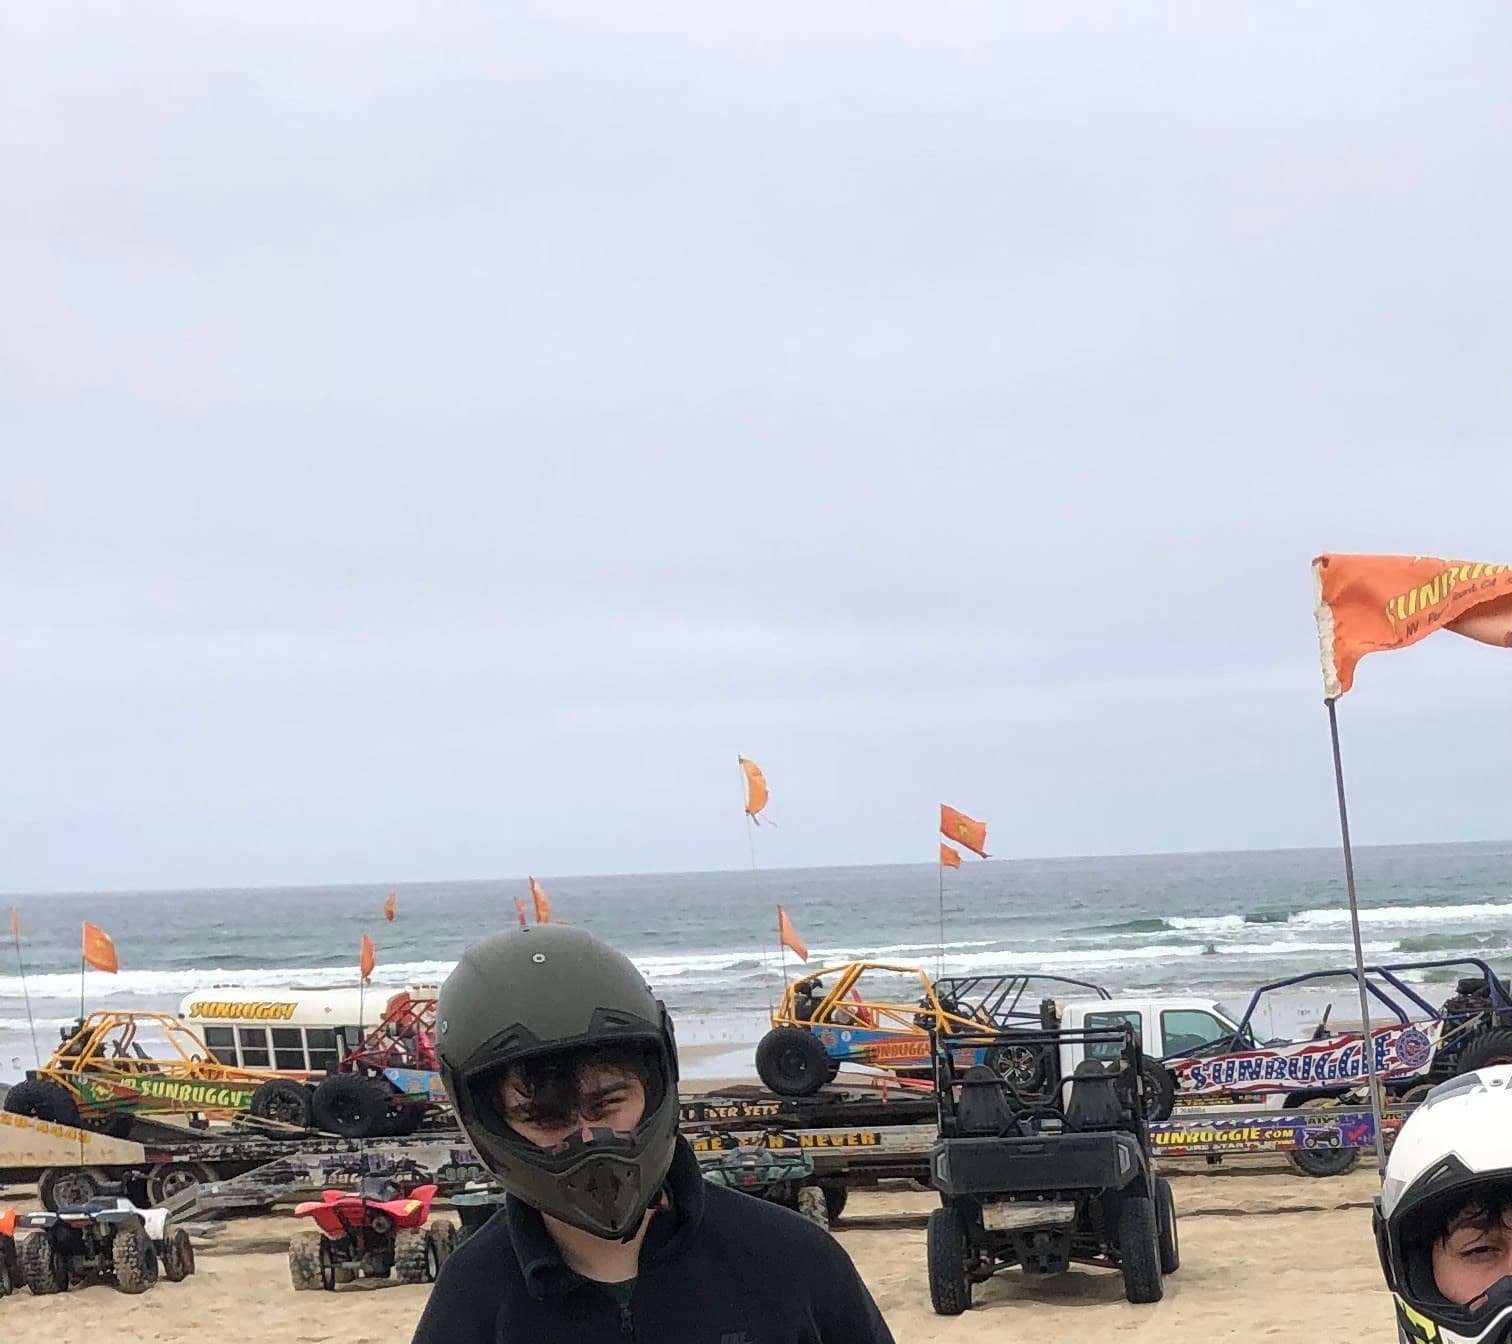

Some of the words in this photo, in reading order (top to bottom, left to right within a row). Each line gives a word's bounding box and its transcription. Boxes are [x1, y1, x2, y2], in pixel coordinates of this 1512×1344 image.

[189, 1001, 298, 1020] SUNBUGGY
[1190, 1032, 1392, 1090] SUNBUGGIE
[141, 1080, 243, 1107] SUNBUGGY
[743, 1103, 780, 1116] SETS
[801, 1132, 876, 1147] NEVER
